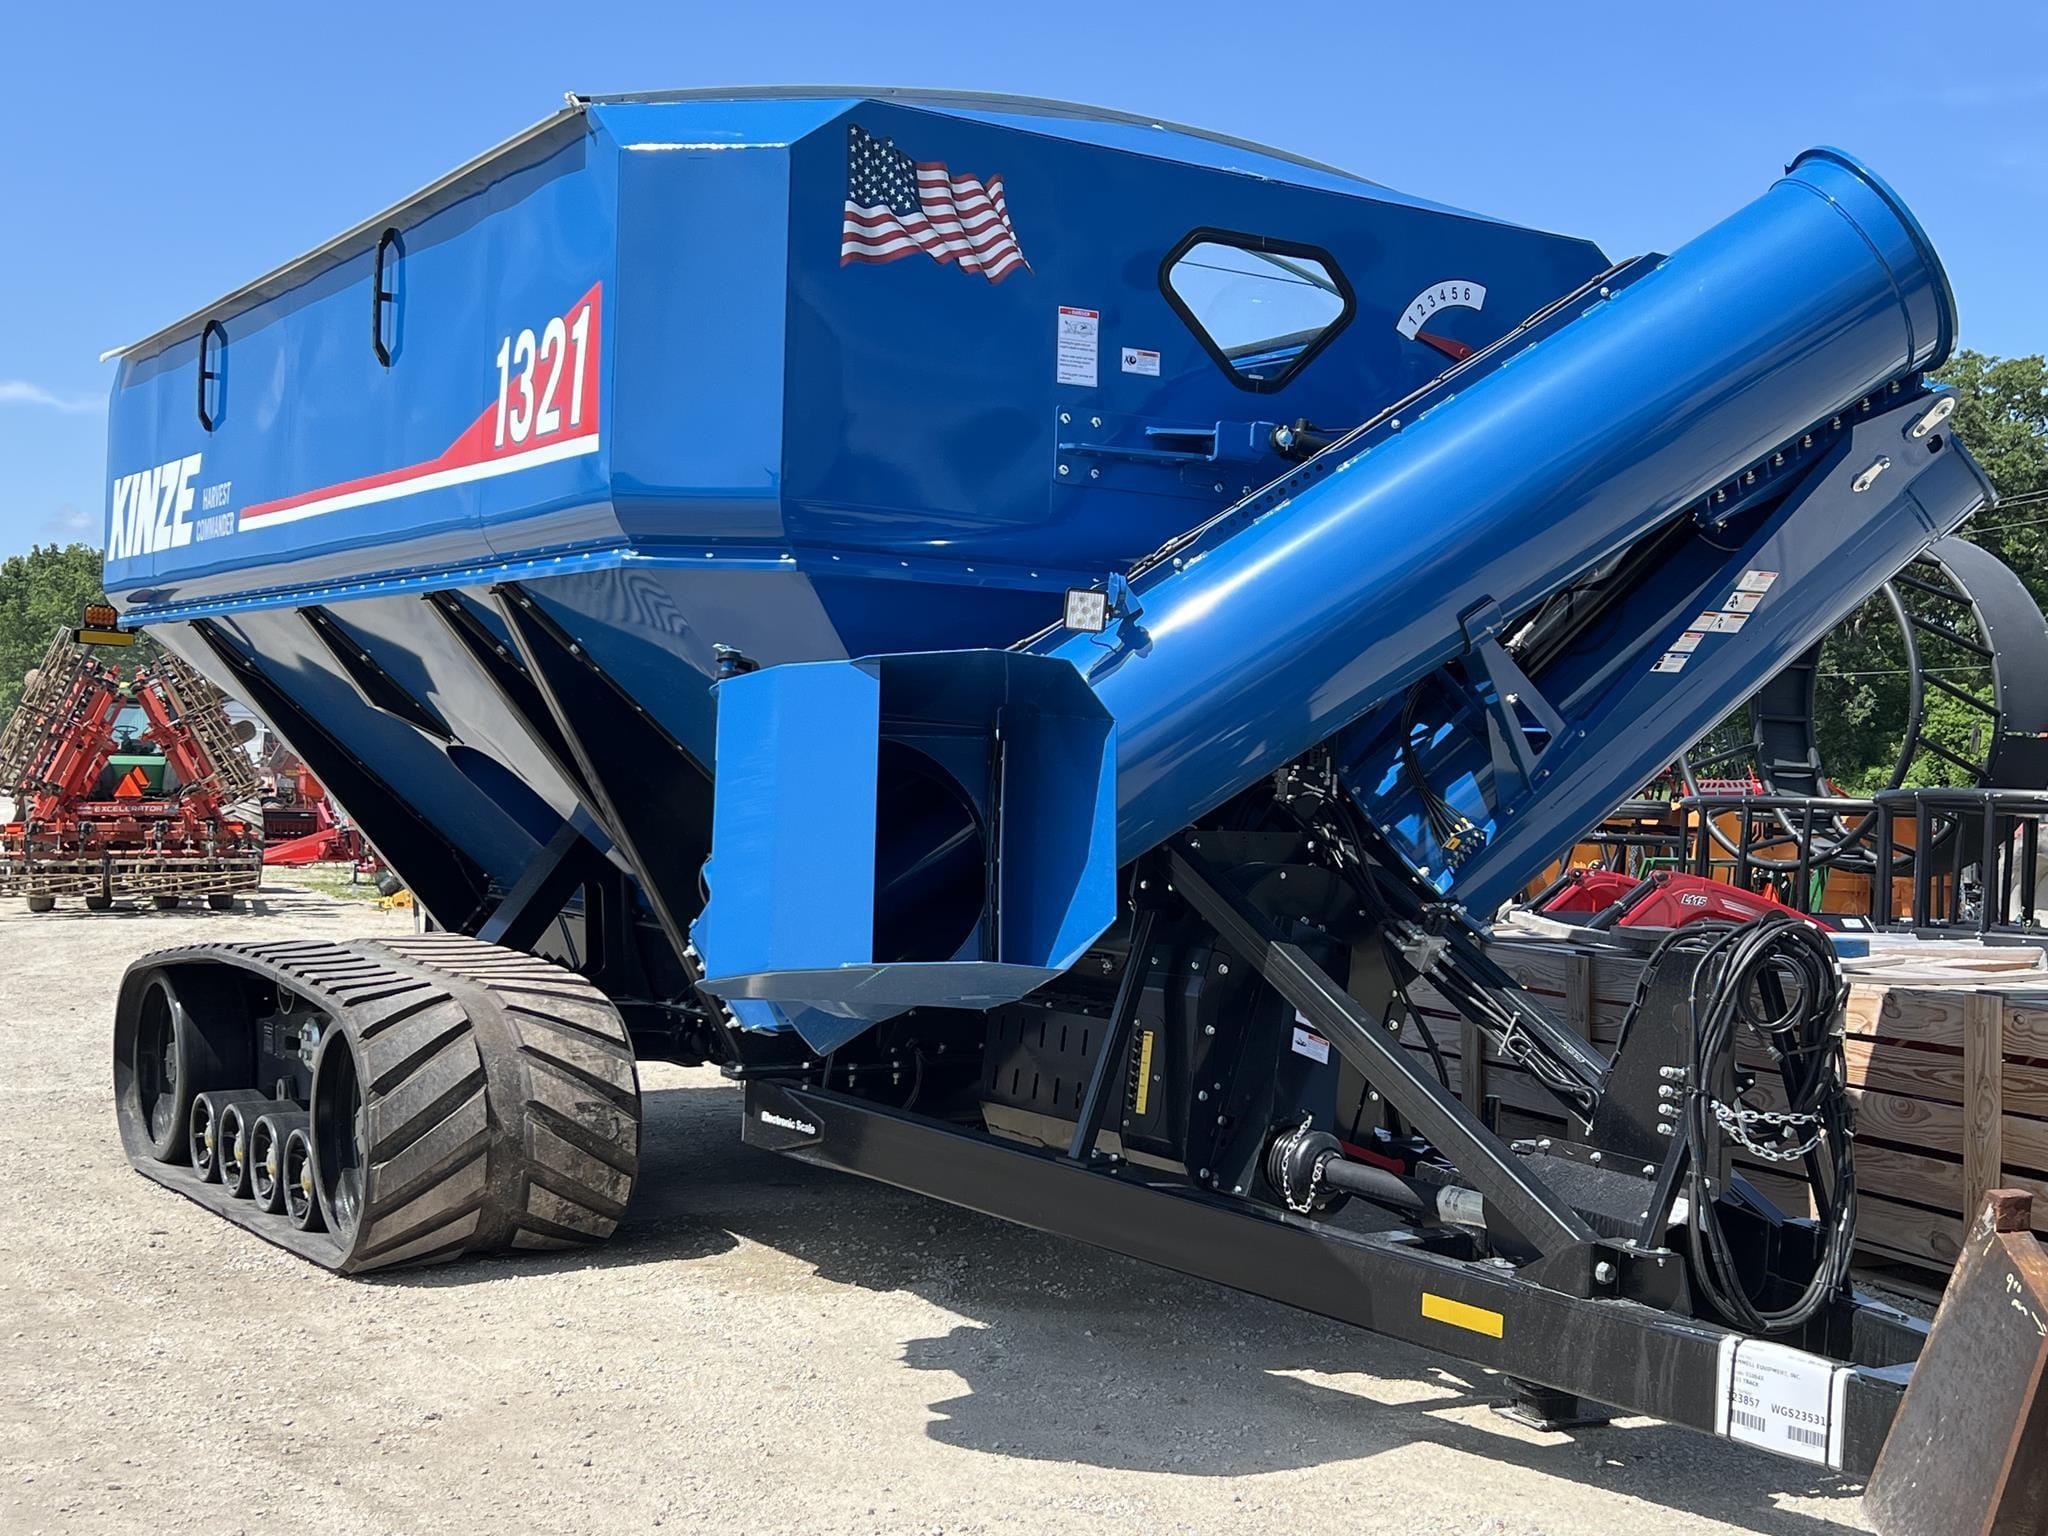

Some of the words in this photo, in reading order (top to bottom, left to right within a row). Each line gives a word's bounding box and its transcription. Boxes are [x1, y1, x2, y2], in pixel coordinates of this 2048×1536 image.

[1408, 315, 1417, 325] 1
[1417, 304, 1426, 316] 2
[1428, 295, 1436, 307] 3
[1440, 289, 1446, 301] 4
[1452, 287, 1458, 300] 5
[1464, 288, 1470, 300] 6
[494, 304, 591, 448] 1321
[107, 452, 202, 562] KINZE
[202, 481, 232, 511] HARVEST
[196, 512, 235, 542] COMMANDER
[94, 805, 163, 813] EXCELLERATOR
[1681, 893, 1708, 907] L115
[761, 1110, 796, 1130] Electronic
[796, 1119, 816, 1135] Scale
[1727, 1390, 1760, 1408] 23857
[1771, 1403, 1832, 1428] WGS23531
